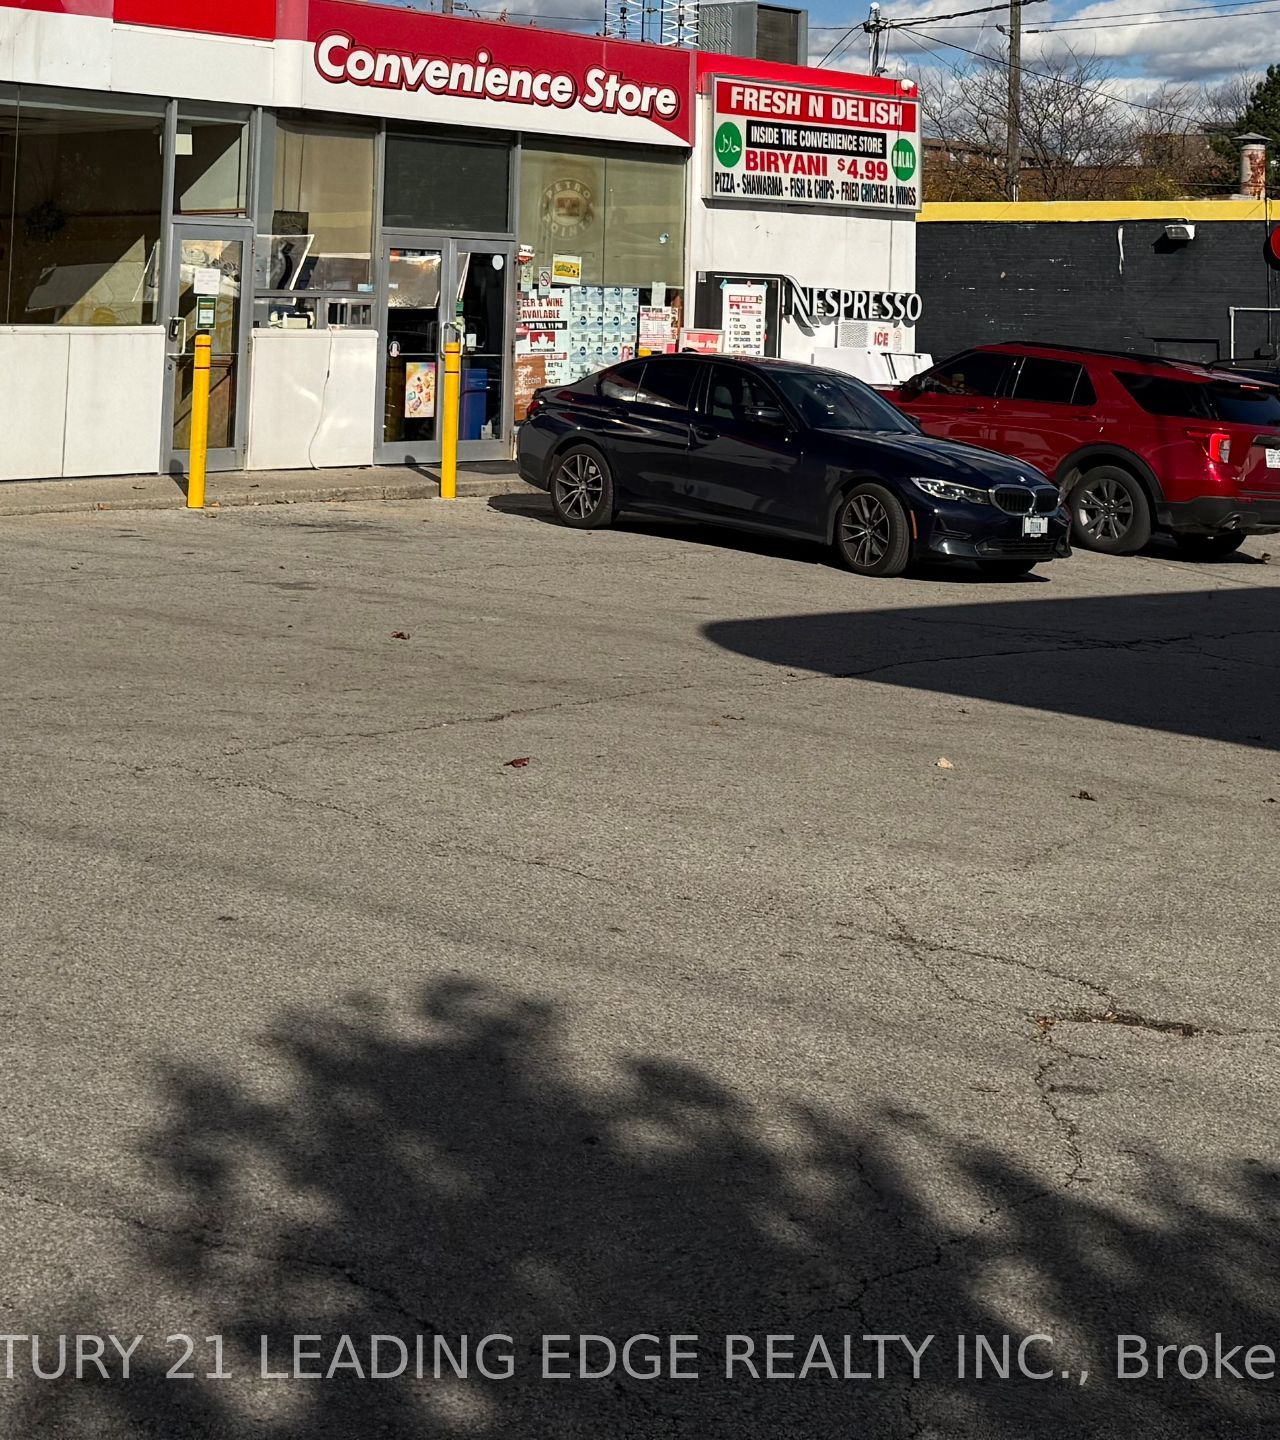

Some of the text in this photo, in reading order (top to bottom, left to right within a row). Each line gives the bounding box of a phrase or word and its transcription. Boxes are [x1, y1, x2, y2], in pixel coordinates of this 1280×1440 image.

[318, 35, 678, 115] Convenience Store
[730, 86, 903, 126] FRESH N DELISH
[751, 125, 883, 154] INSIDE THE CONVENIENCE STORE
[745, 149, 888, 181] BIRYANI $4.99
[715, 171, 917, 206] PIZZA SHAWARMA FISH & CHIPS FRIED CHICKEN & WINGS
[522, 310, 560, 318] AVAILABLE
[786, 277, 923, 326] NESPRESSO
[873, 331, 889, 347] ICE
